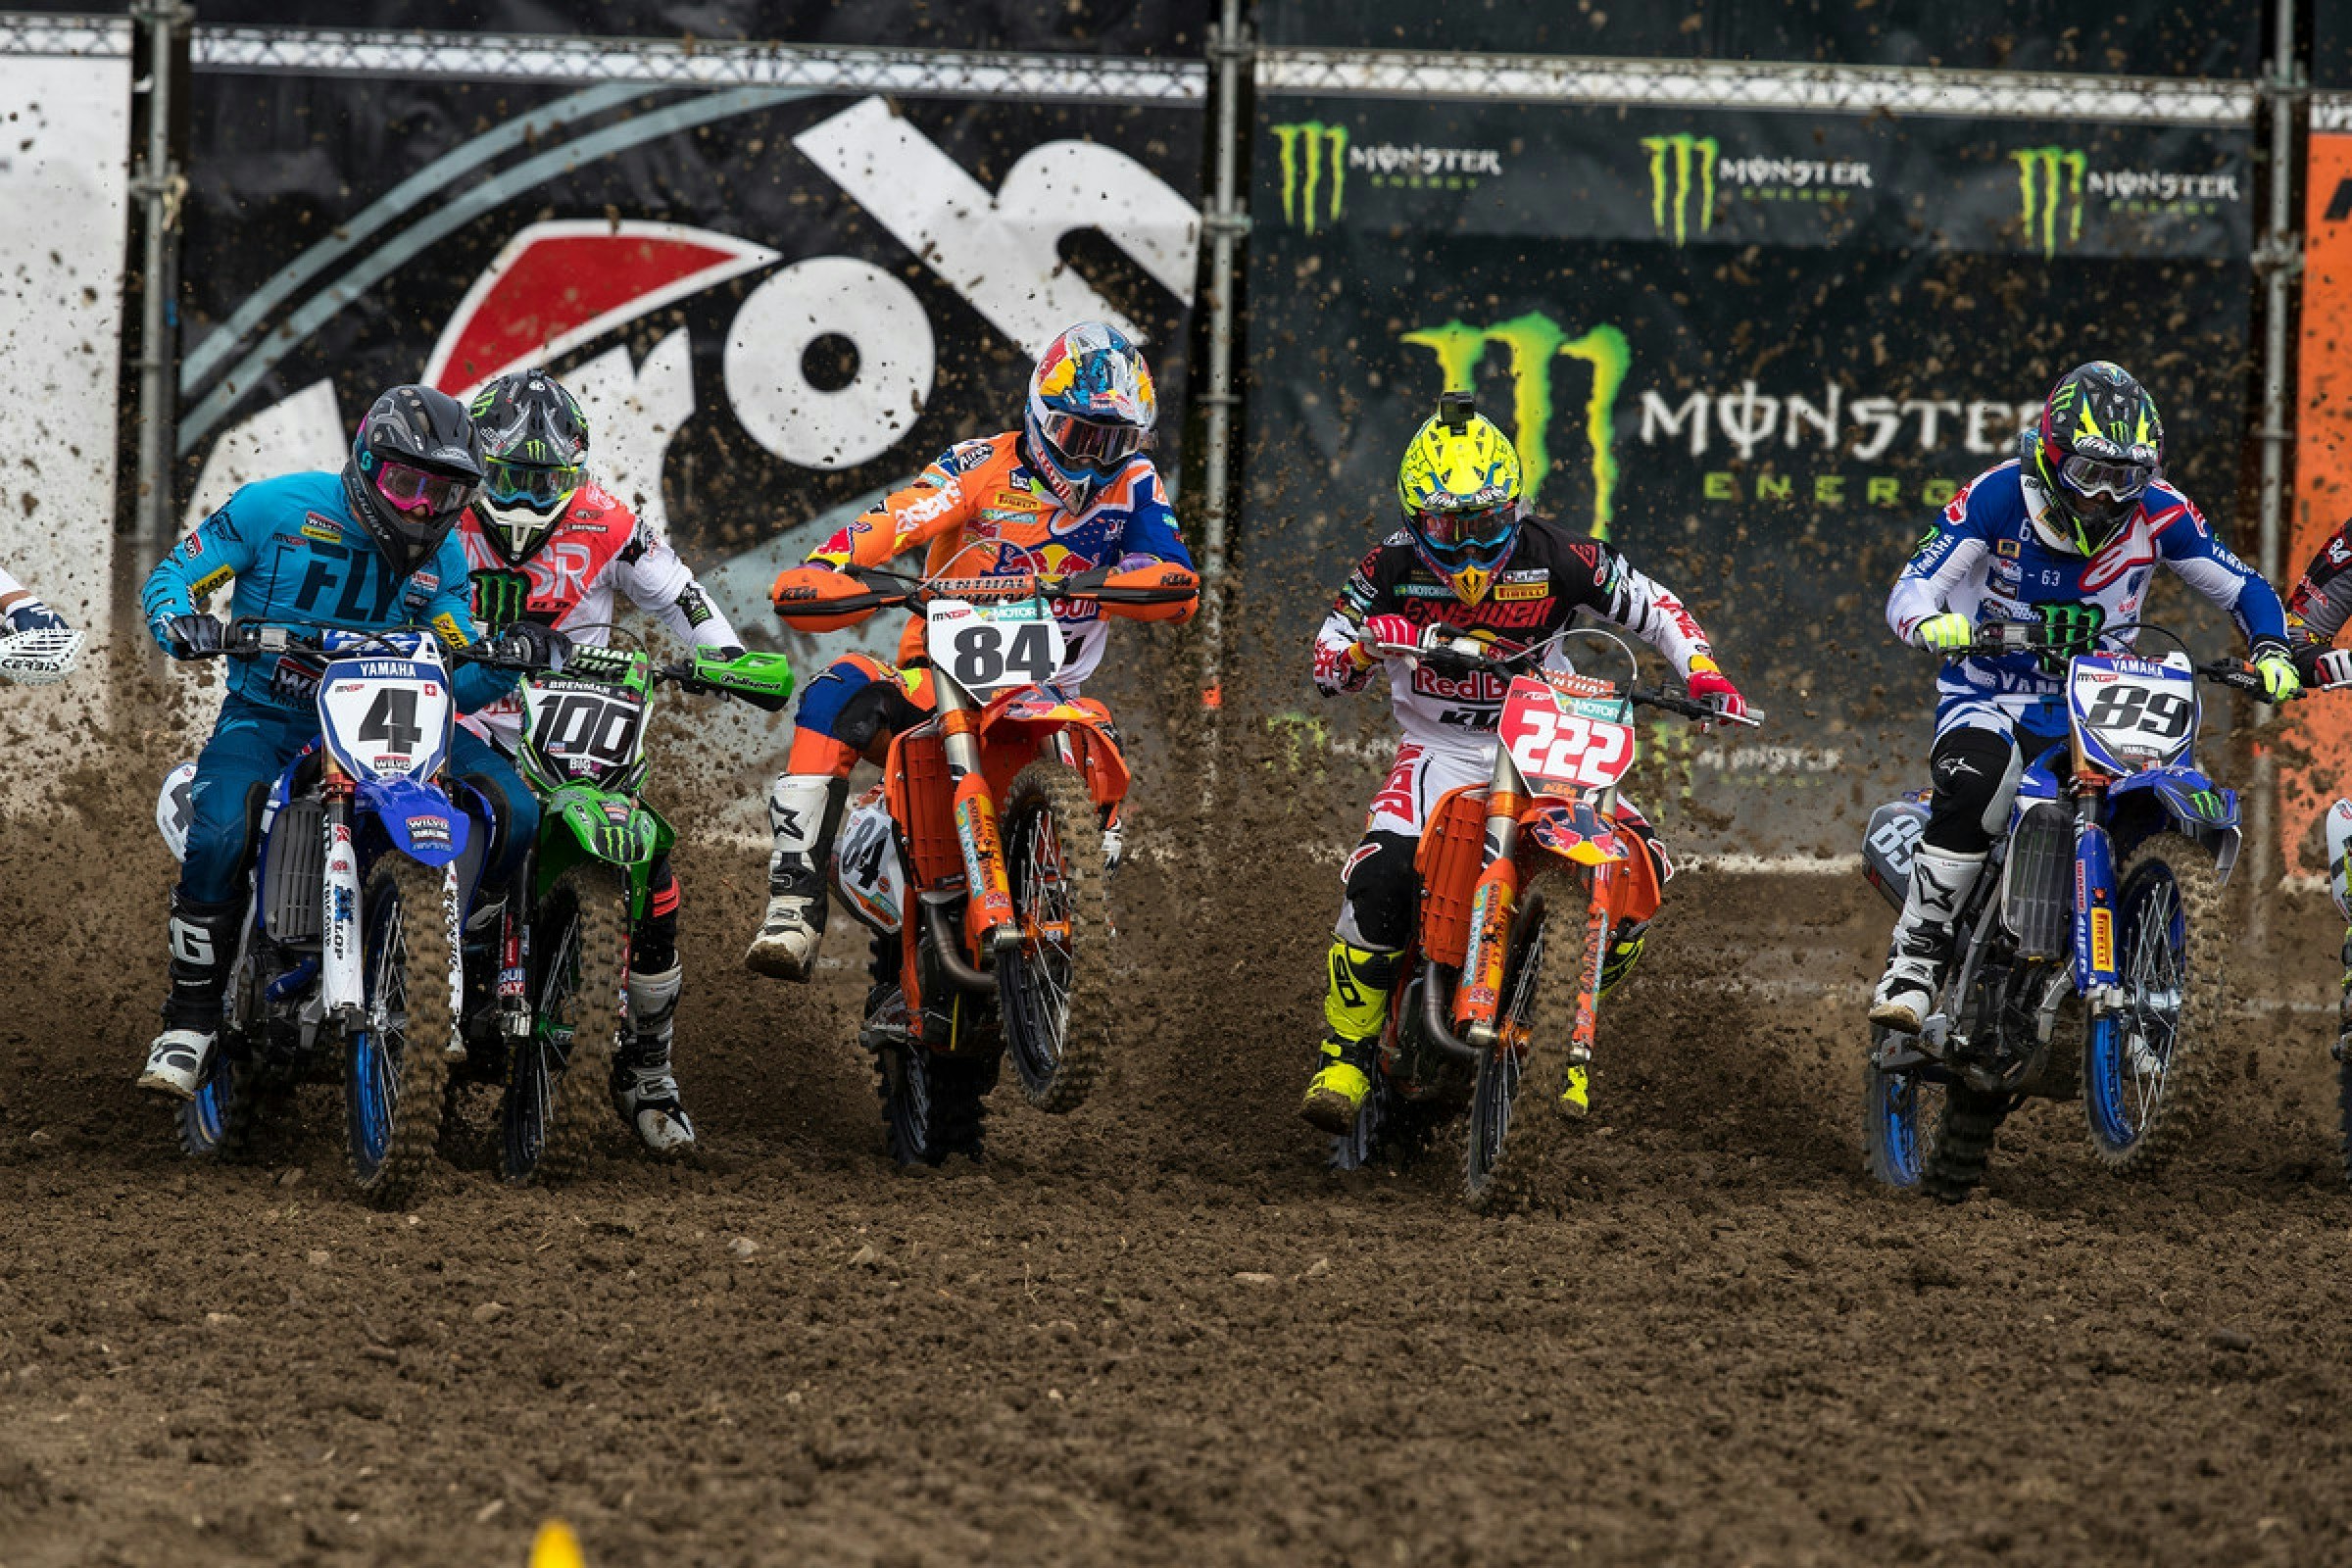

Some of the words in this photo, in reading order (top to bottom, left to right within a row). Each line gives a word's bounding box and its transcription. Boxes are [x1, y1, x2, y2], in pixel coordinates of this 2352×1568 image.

[1349, 142, 1502, 175] MONSTER
[1719, 155, 1874, 188] MONSTER
[2087, 169, 2240, 202] MONSTER
[1703, 471, 1958, 506] ENERG
[2041, 568, 2061, 586] 63
[1, 658, 60, 671] CERBIS
[360, 662, 416, 677] YAMAHA
[954, 624, 1055, 685] 84
[2111, 659, 2164, 678] YAMAHA
[359, 688, 421, 755] 4
[2089, 685, 2187, 737] 89
[532, 694, 640, 764] 100
[1511, 710, 1629, 784] 222
